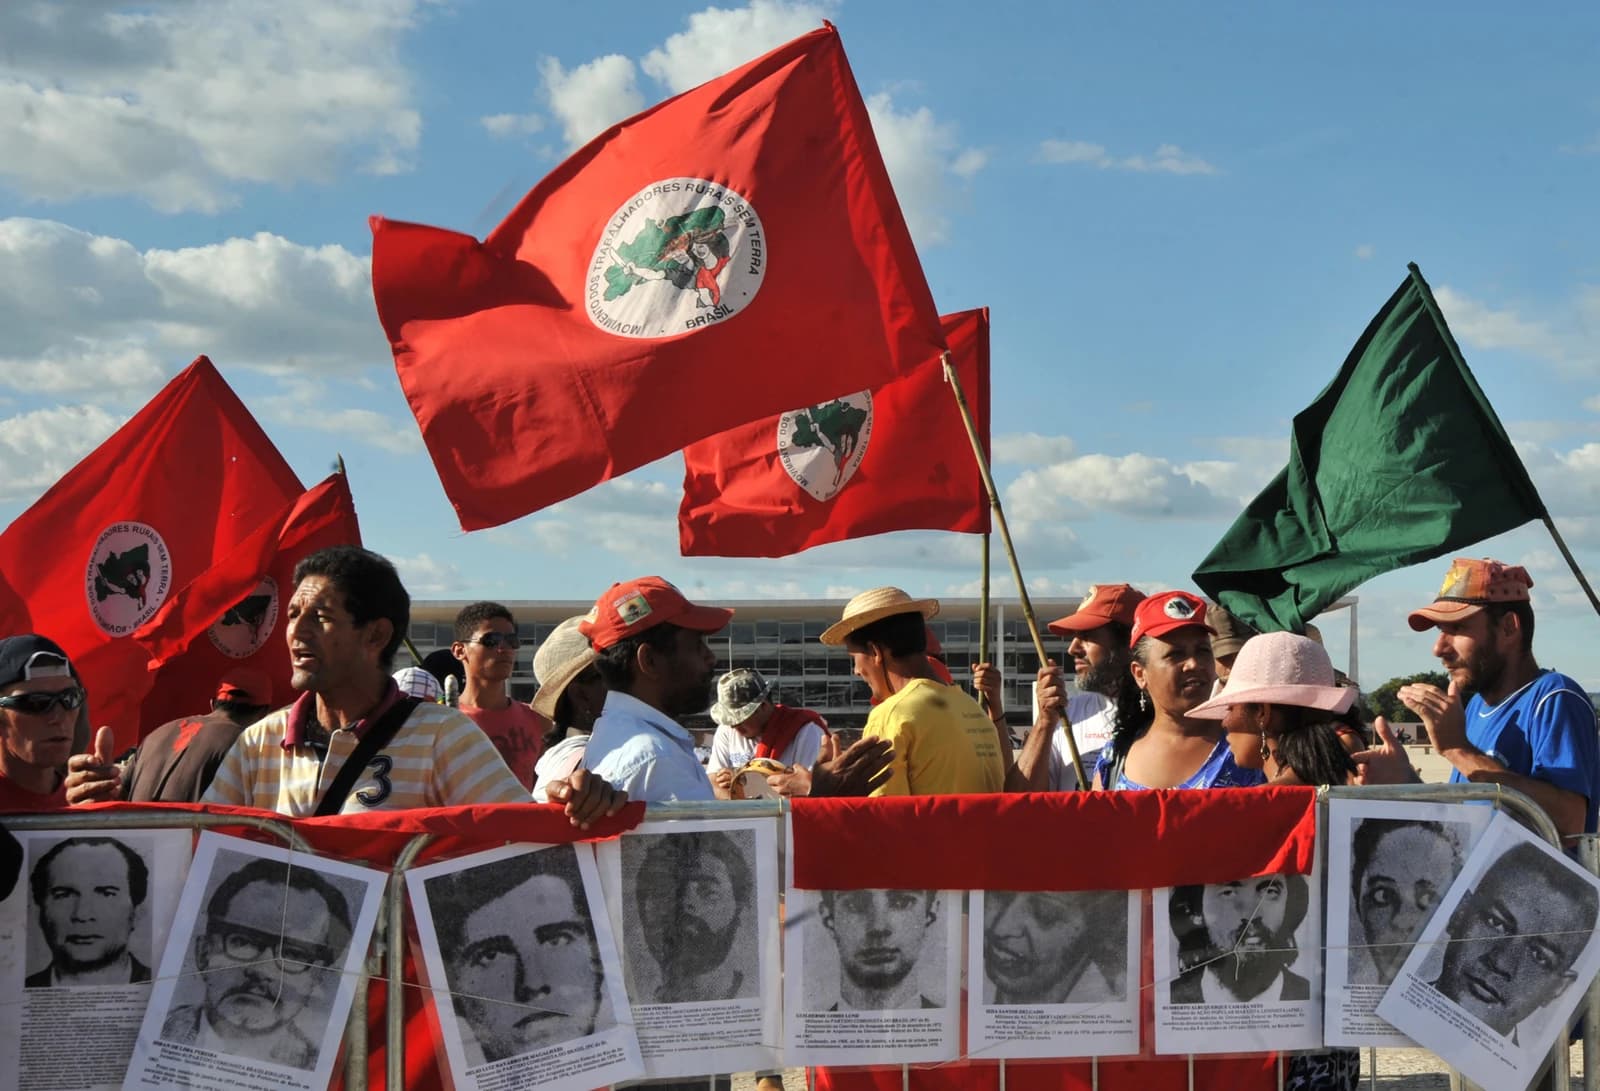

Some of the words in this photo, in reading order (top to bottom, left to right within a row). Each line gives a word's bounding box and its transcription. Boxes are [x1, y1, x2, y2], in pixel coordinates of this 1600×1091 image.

[685, 183, 735, 206] RURAIS
[593, 182, 681, 272] TRABALHADORES
[733, 202, 756, 229] SEM
[749, 231, 762, 275] TERRA
[589, 276, 601, 300] DOS
[590, 301, 642, 335] MOVIMENTO
[686, 304, 735, 330] BRASIL
[156, 563, 169, 595] TERRA
[355, 755, 393, 807] 3
